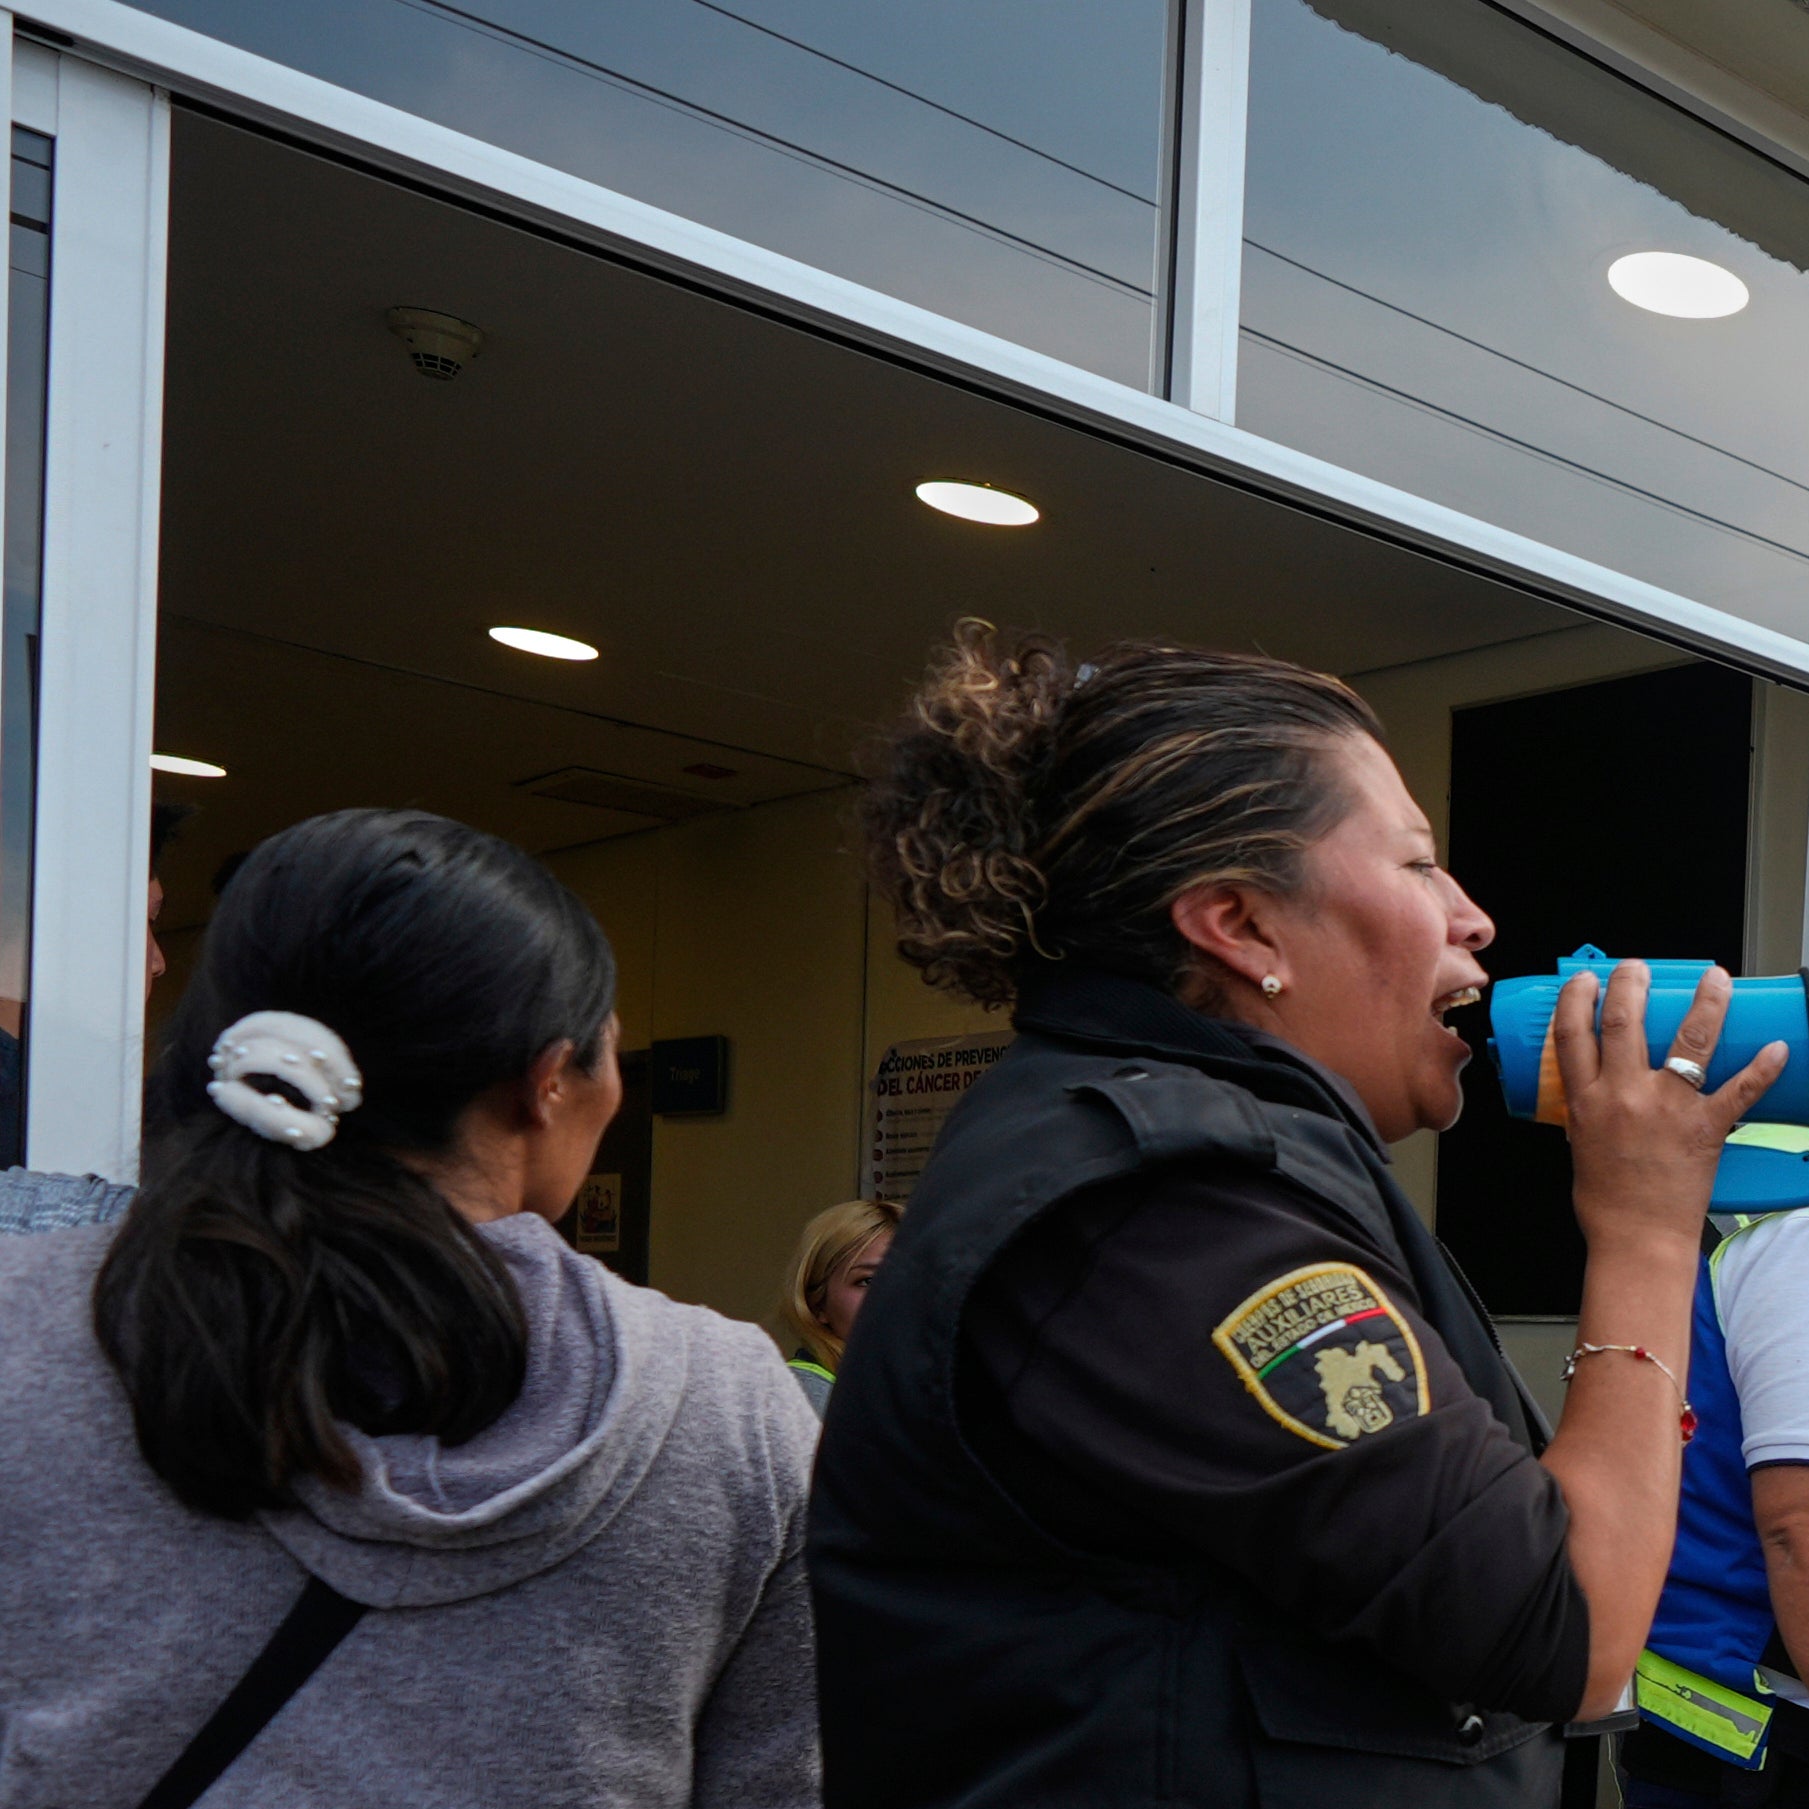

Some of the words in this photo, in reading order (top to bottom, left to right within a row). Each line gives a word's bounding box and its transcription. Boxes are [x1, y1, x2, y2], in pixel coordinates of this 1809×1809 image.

[938, 1051, 954, 1068] DE
[955, 1045, 1010, 1065] PREVENC
[878, 1077, 903, 1097] DEL
[906, 1072, 960, 1094] CÁNCER
[1246, 1286, 1364, 1355] AUXILIARES
